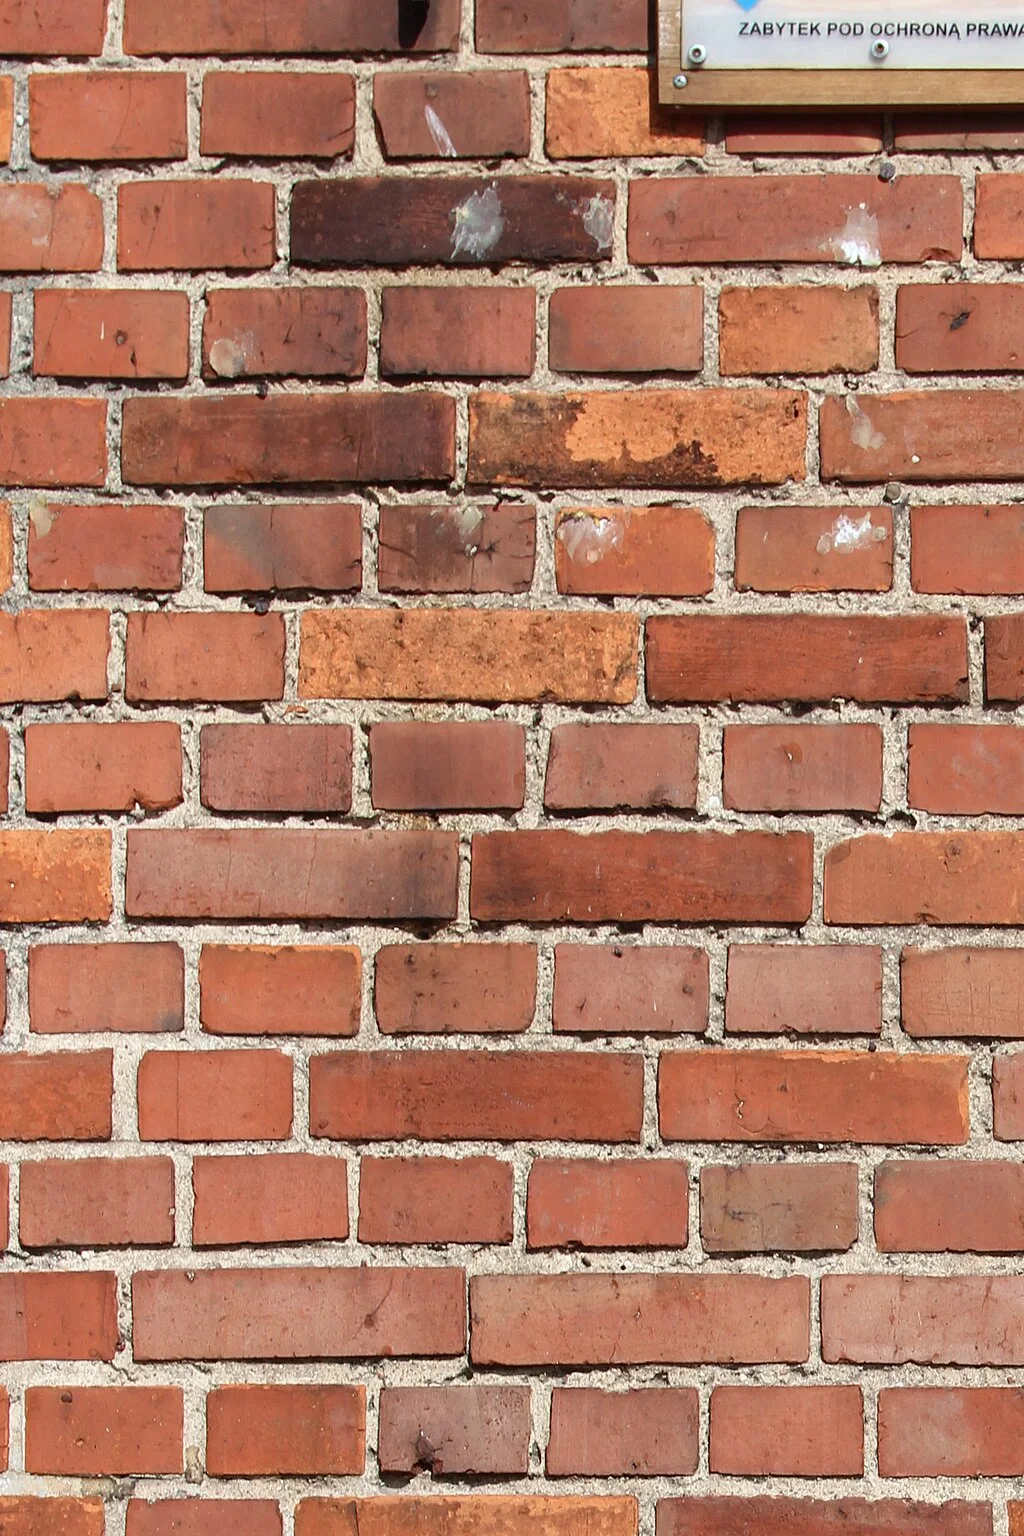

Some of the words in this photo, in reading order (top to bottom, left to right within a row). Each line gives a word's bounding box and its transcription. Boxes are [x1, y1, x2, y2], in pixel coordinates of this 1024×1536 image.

[739, 22, 821, 36] ZABYTEK
[827, 22, 864, 36] POD
[870, 22, 960, 40] OCHRONĄ
